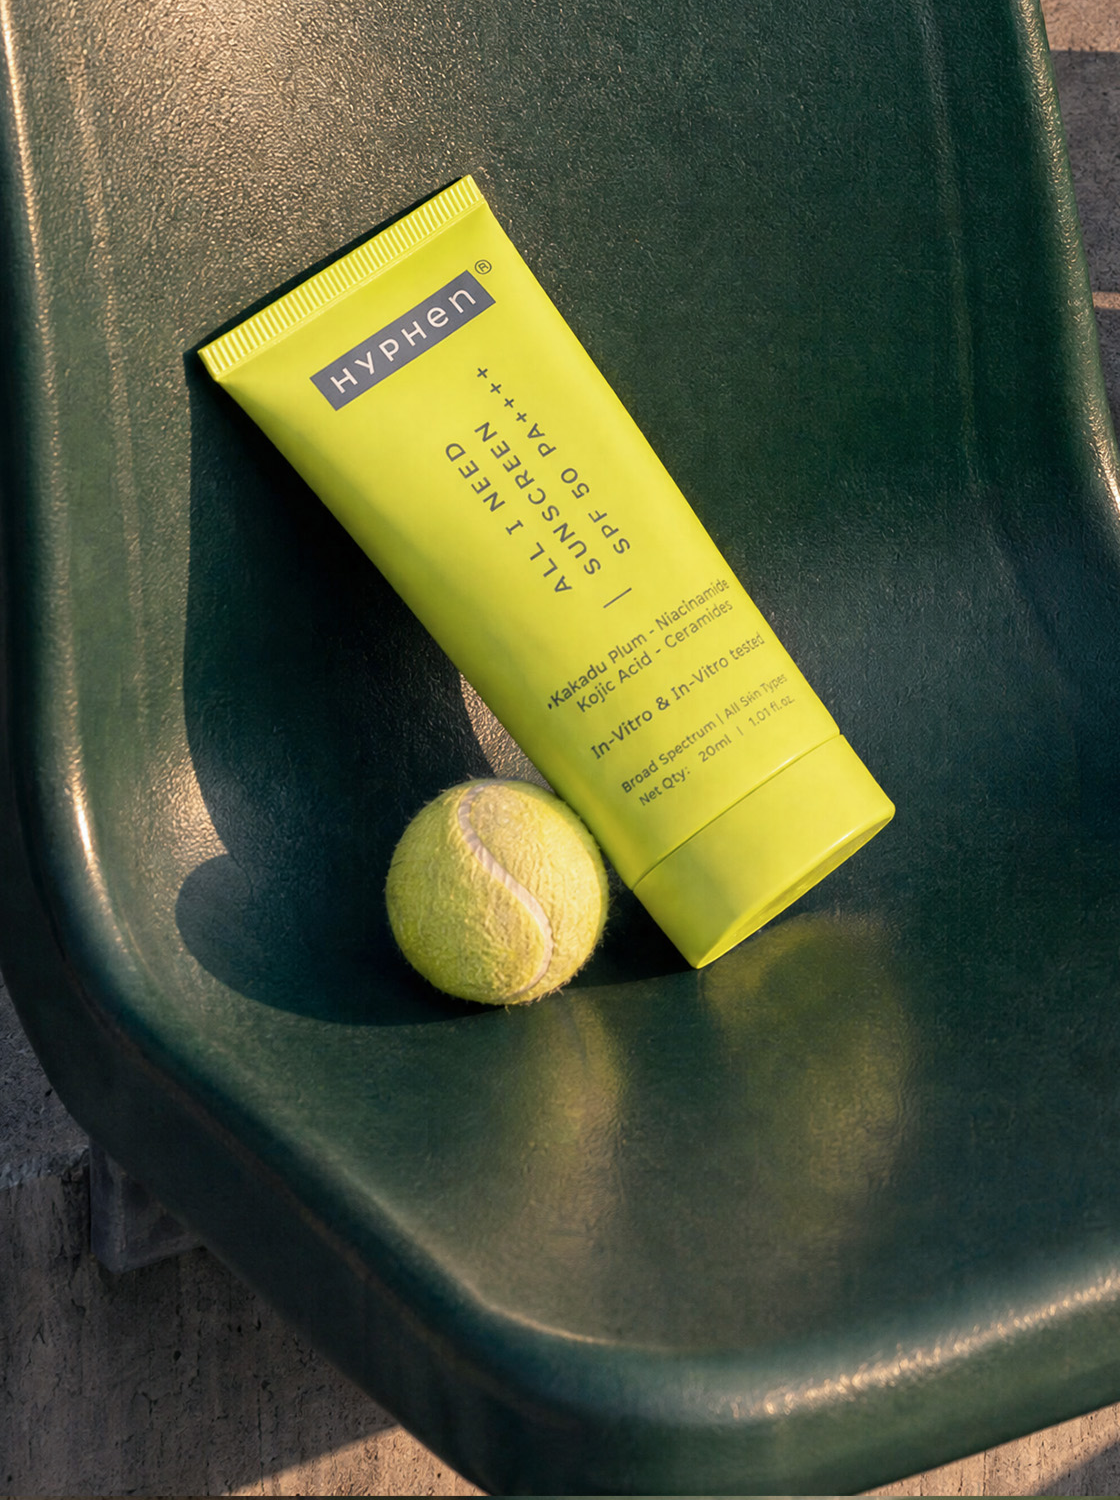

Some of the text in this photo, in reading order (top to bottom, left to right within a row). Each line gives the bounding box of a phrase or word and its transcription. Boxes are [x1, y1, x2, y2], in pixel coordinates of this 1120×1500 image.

[445, 443, 572, 592] ALL I NEED
[474, 422, 601, 575] SUNSCREEN
[561, 468, 590, 499] 50
[588, 510, 630, 554] SPF
[576, 681, 616, 712] Kojic
[618, 651, 652, 684] Acid
[664, 600, 733, 648] Ceramides
[608, 634, 647, 664] Plum
[655, 579, 729, 631] Niacinamide
[591, 632, 765, 759] In-Vitro & In-Vitro tested
[621, 760, 659, 793] Broad
[658, 721, 717, 765] Spectrum
[724, 702, 741, 719] All
[739, 690, 762, 707] Skin
[760, 674, 787, 693] Types
[639, 786, 662, 806] Net
[662, 767, 690, 789] Qty:
[698, 734, 732, 763] 20ml
[748, 707, 771, 726] 1.01
